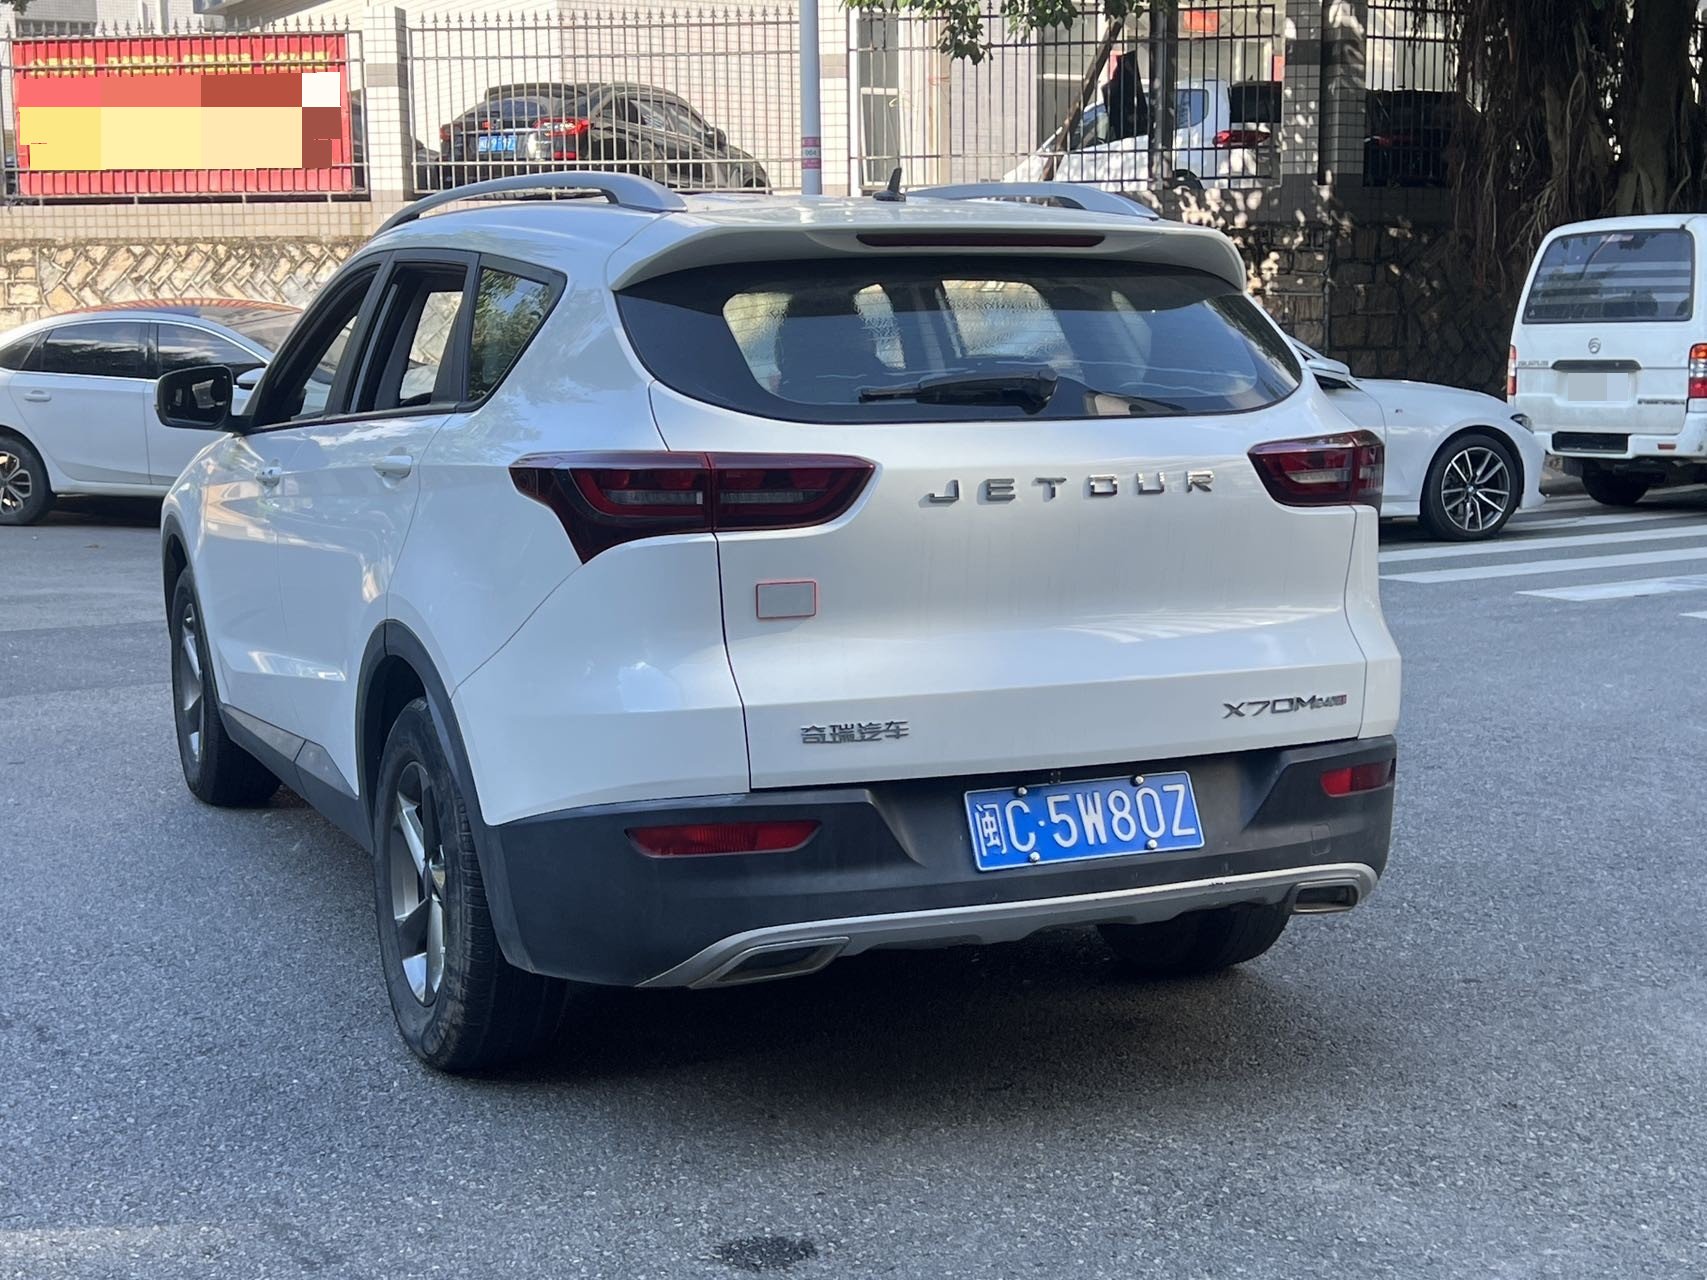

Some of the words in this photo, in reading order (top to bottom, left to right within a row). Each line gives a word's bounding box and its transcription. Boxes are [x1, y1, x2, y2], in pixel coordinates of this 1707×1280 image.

[926, 470, 1215, 503] JETOUR
[801, 721, 909, 744] 奇瑞汽车
[974, 784, 1197, 857] 闽C·5W80Z
